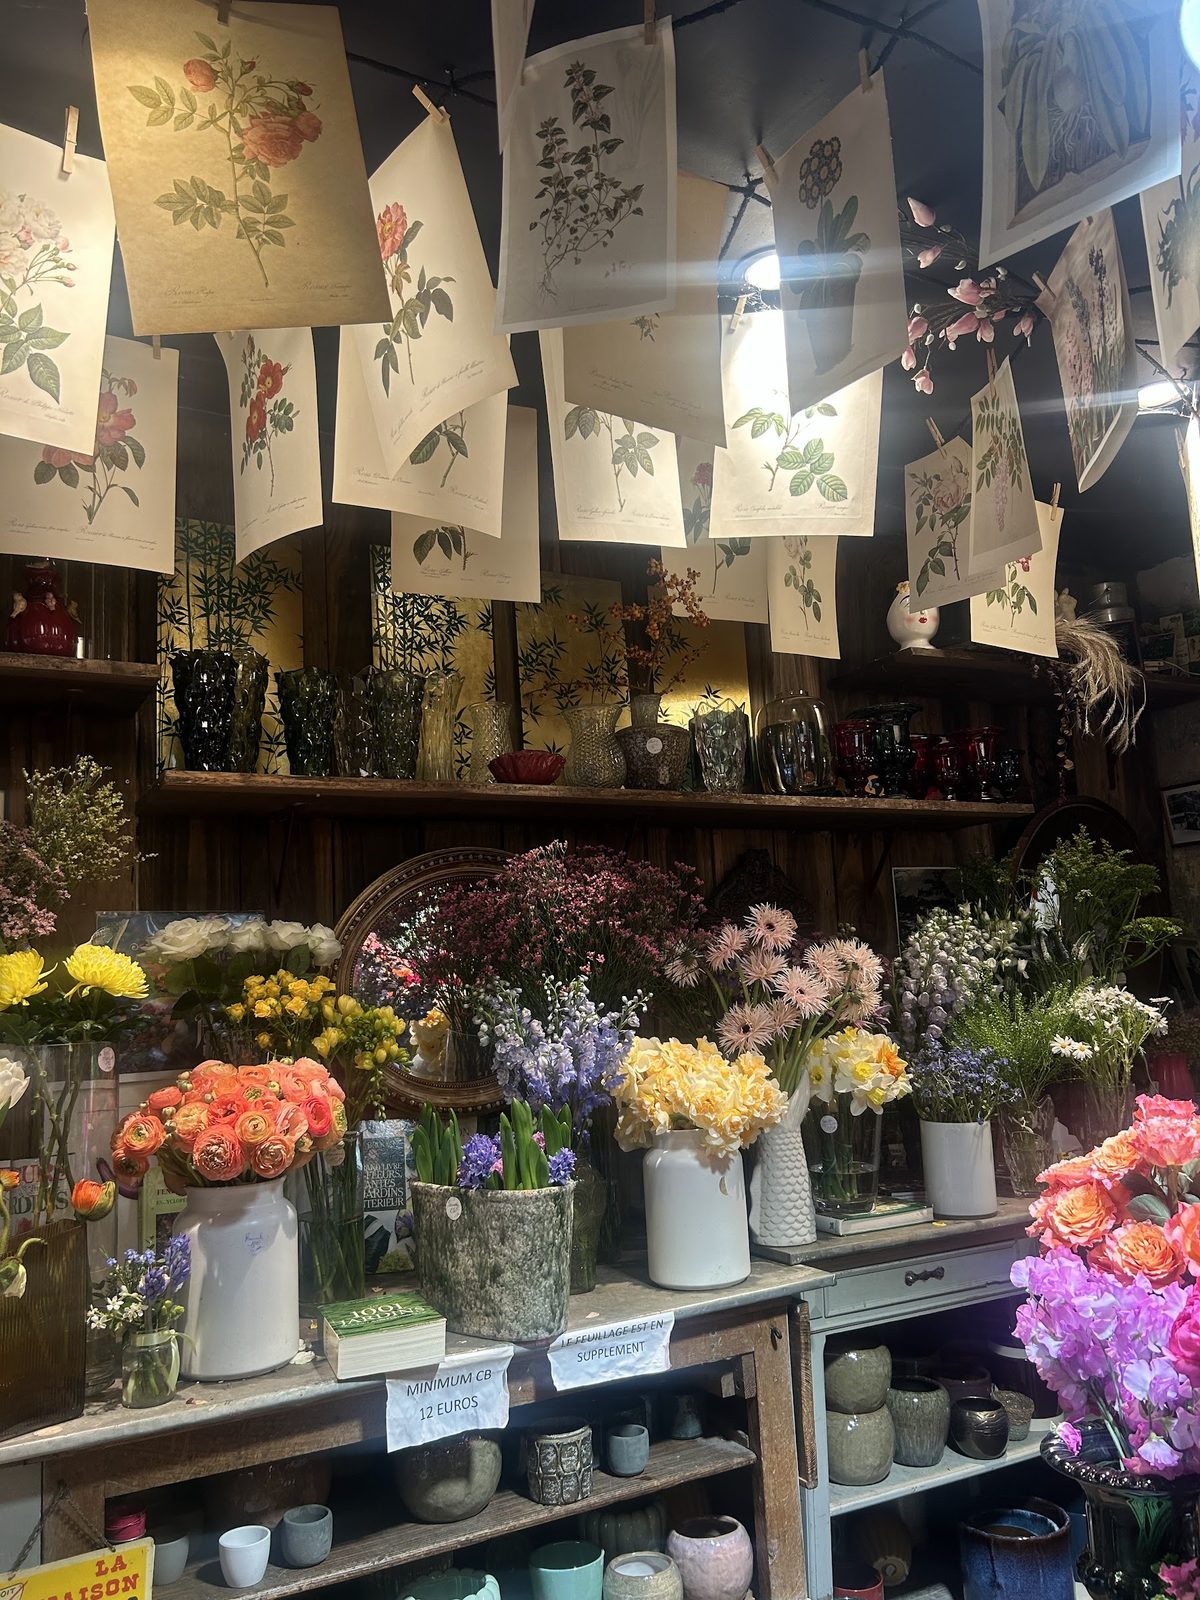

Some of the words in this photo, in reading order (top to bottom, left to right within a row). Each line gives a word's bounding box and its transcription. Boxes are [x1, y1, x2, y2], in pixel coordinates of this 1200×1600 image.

[338, 1306, 425, 1327] JARDINS
[350, 1302, 404, 1319] 1001
[560, 1337, 573, 1348] LE
[574, 1326, 629, 1345] FEUILLAGE
[630, 1321, 649, 1334] EST
[650, 1319, 664, 1331] EN
[577, 1340, 646, 1363] SUPPLEMENT
[406, 1372, 473, 1397] MINIMUM
[476, 1369, 492, 1382] CB
[419, 1405, 434, 1421] 12
[437, 1395, 479, 1416] EUROS
[95, 1554, 127, 1577] LA
[41, 1573, 140, 1600] AISON
